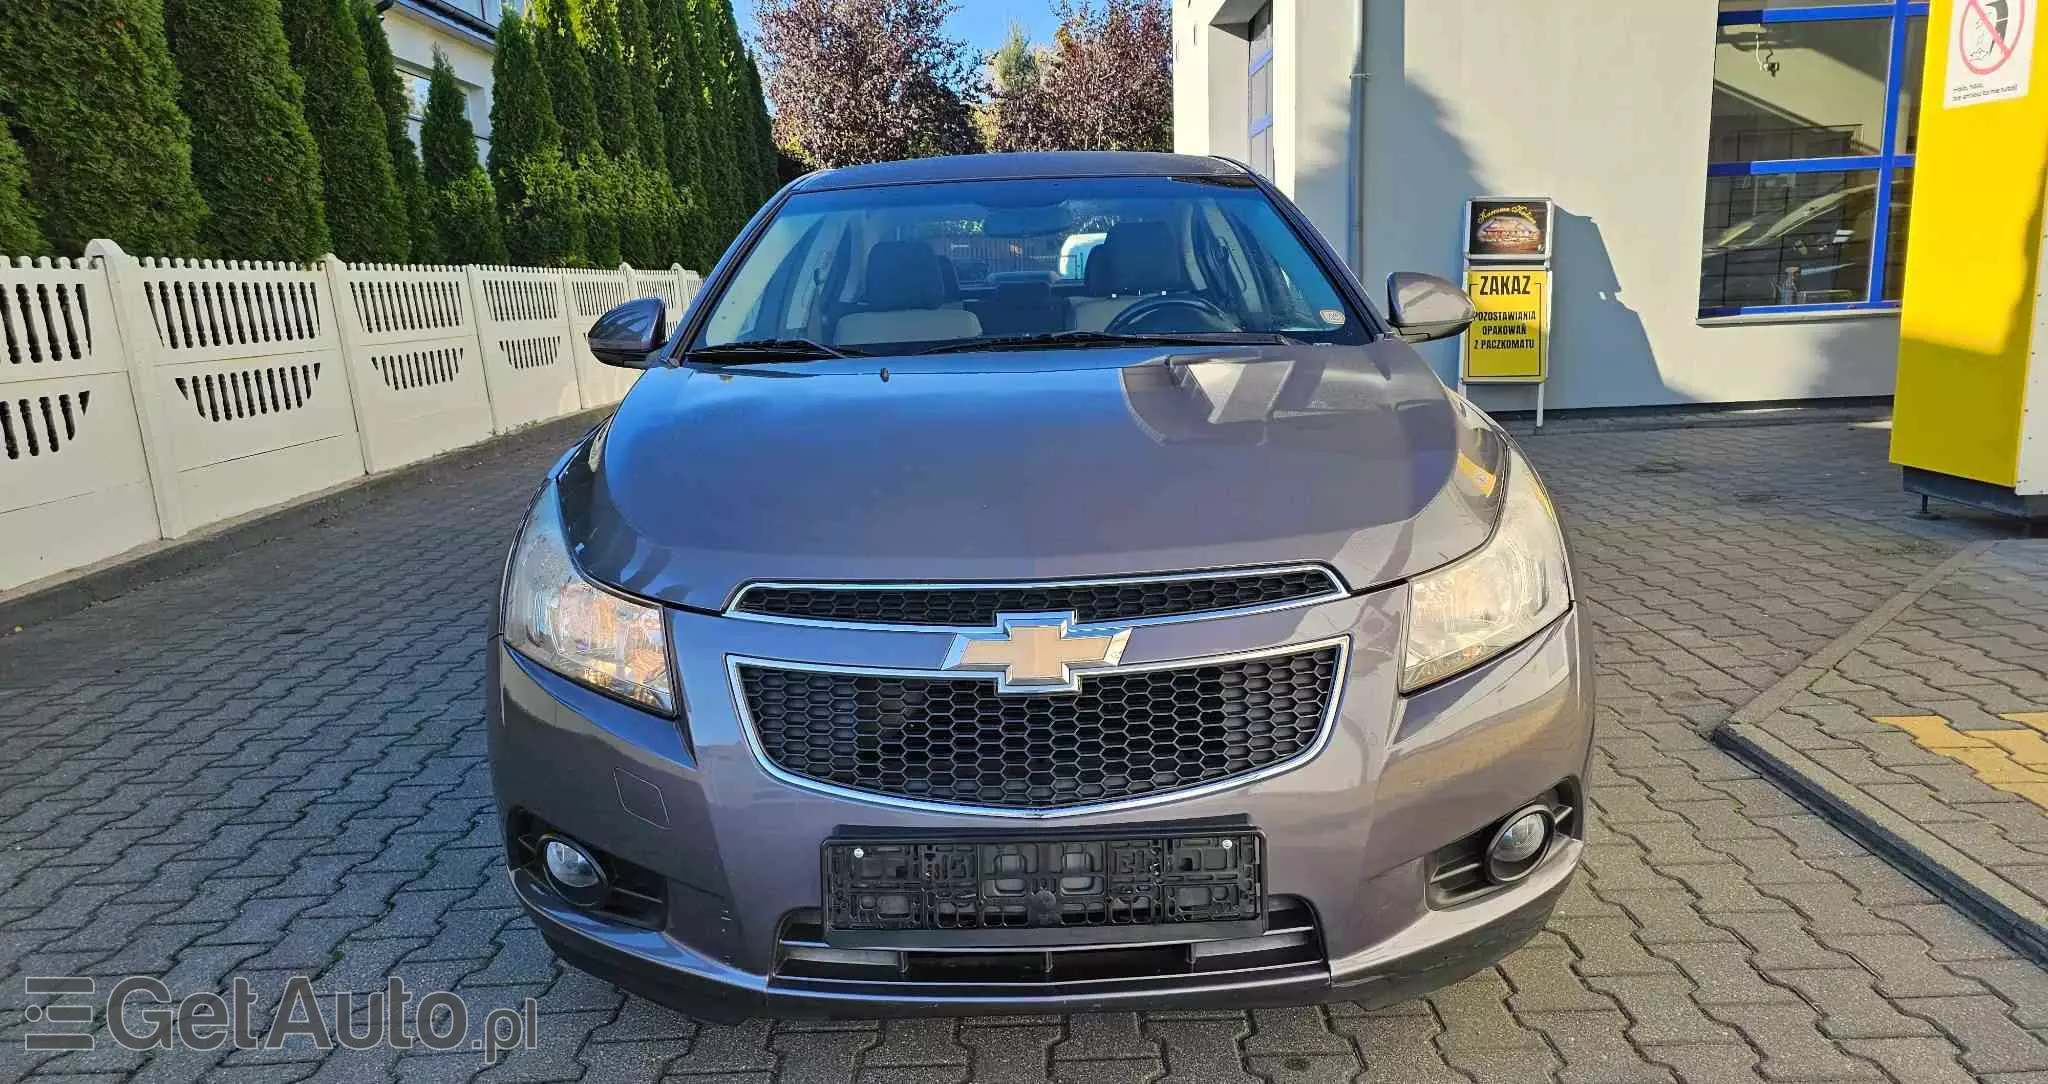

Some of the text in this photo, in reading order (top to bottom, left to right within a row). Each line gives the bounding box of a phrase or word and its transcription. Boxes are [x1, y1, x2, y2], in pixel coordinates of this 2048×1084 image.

[1480, 275, 1530, 295] ZAKAZ
[1473, 311, 1536, 321] POZOSTAWIANIA
[1482, 323, 1527, 336] OPAKOWAŃ
[1474, 339, 1535, 350] Z PACZKOMATU
